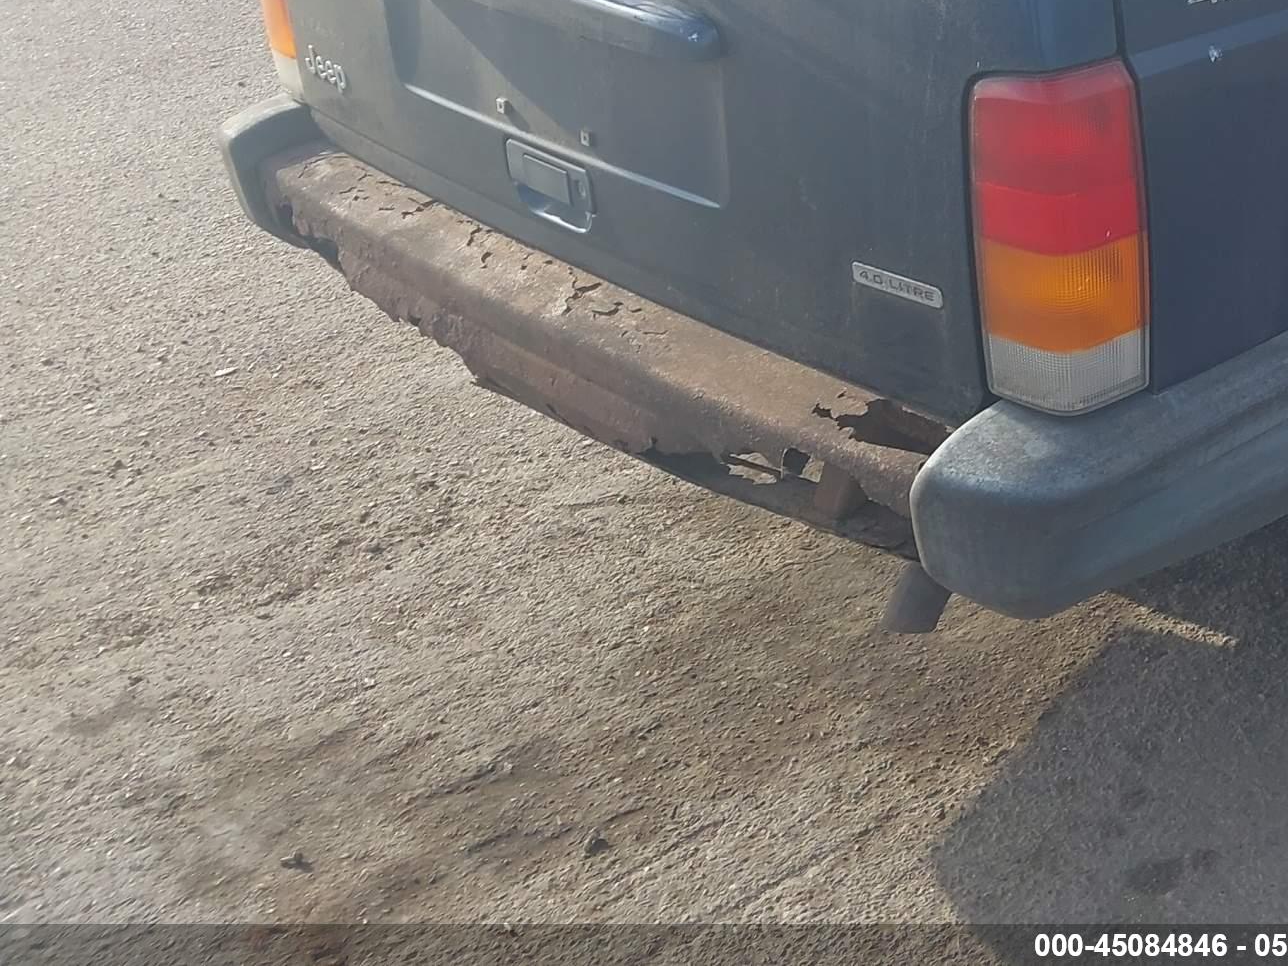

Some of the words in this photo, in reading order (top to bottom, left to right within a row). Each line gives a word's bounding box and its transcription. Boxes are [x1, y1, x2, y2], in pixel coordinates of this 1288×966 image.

[304, 44, 347, 94] Jeep
[859, 270, 883, 286] 4.0
[888, 278, 936, 302] LITRE
